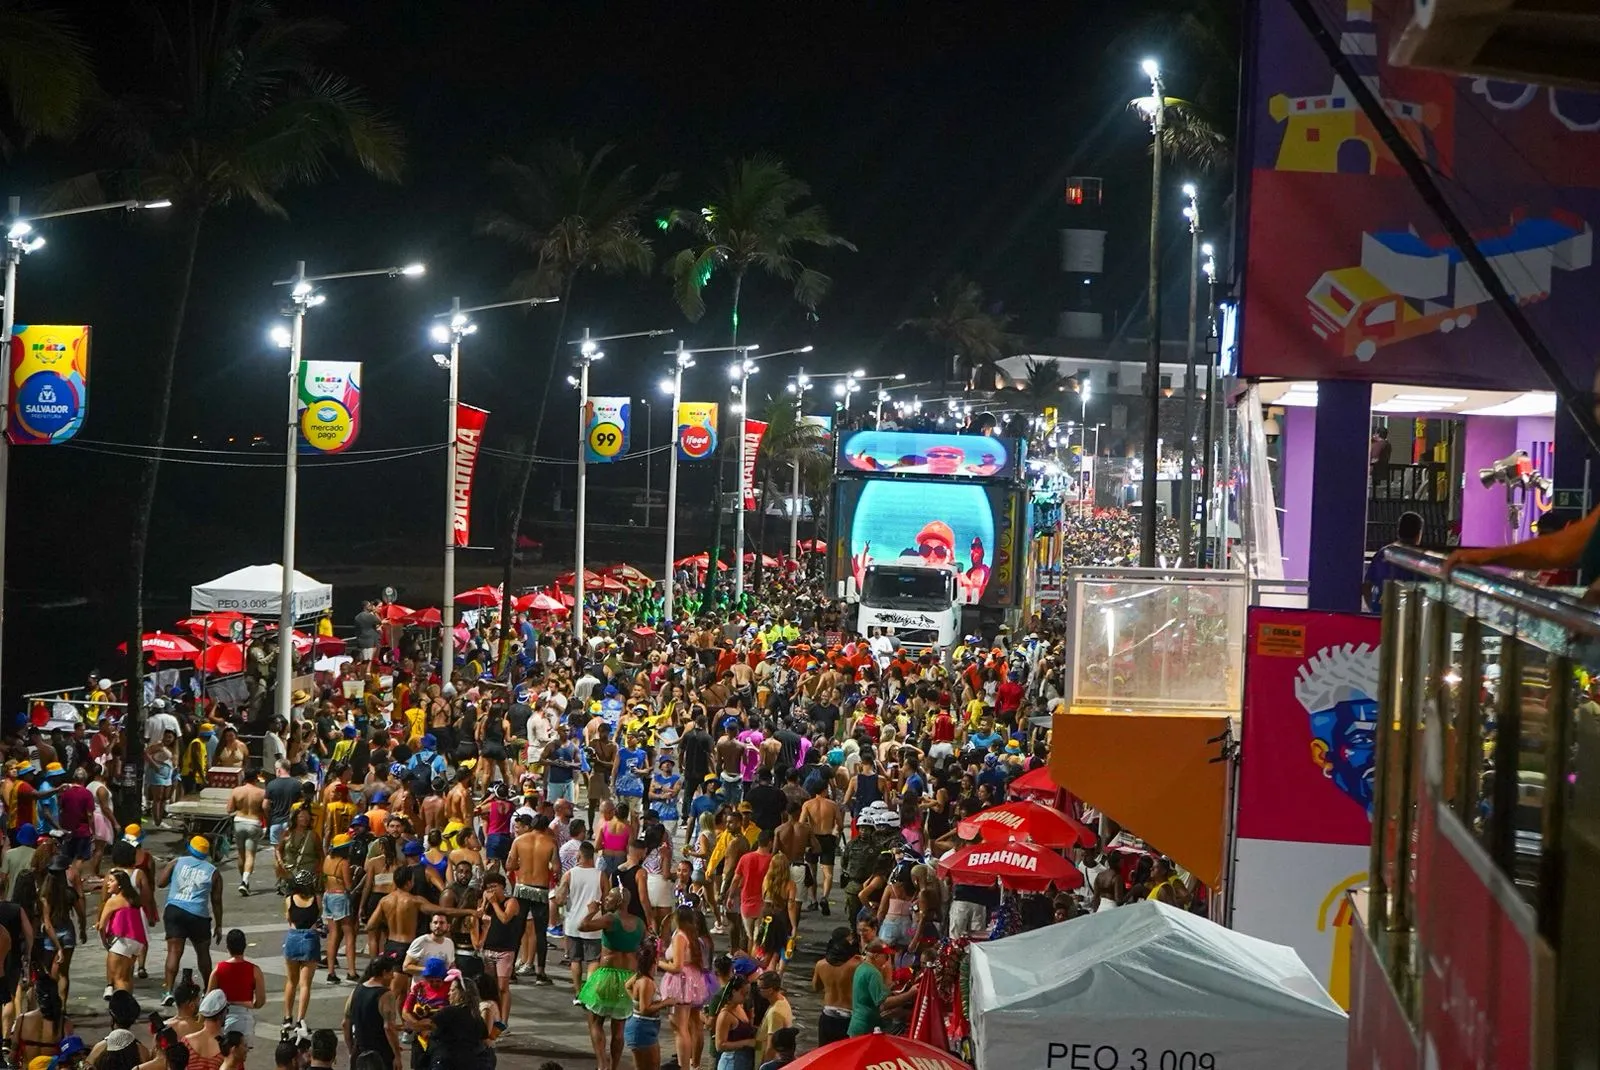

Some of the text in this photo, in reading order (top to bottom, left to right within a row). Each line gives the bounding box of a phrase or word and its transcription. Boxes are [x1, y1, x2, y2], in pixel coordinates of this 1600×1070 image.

[25, 404, 69, 414] SALVADOR
[311, 424, 344, 432] mercado
[318, 431, 337, 440] pago
[597, 432, 616, 447] 99
[218, 599, 268, 609] PEO 3.008
[142, 638, 176, 650] RAHMA
[973, 811, 1026, 830] BRAHMA
[967, 850, 1038, 872] BRAHMA
[1047, 1042, 1119, 1070] PEO
